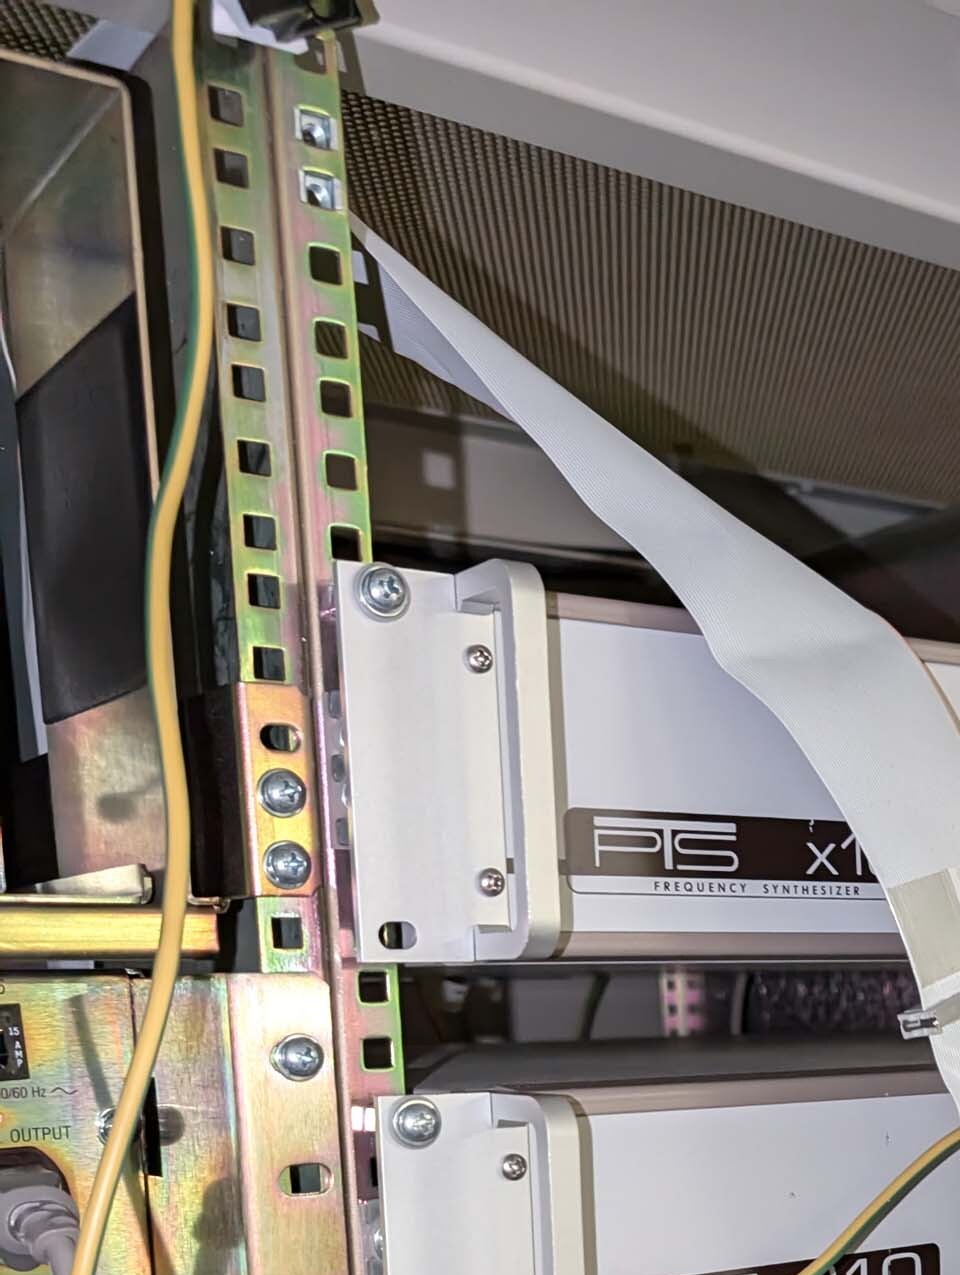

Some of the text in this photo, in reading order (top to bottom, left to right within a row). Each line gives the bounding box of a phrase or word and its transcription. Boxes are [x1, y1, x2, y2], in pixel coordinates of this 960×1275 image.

[805, 834, 878, 876] x1
[654, 880, 861, 897] FREQUENCY SYNTHESIZER
[8, 1027, 20, 1036] 15
[32, 1086, 47, 1099] Hz
[10, 1126, 71, 1143] OUTPUT
